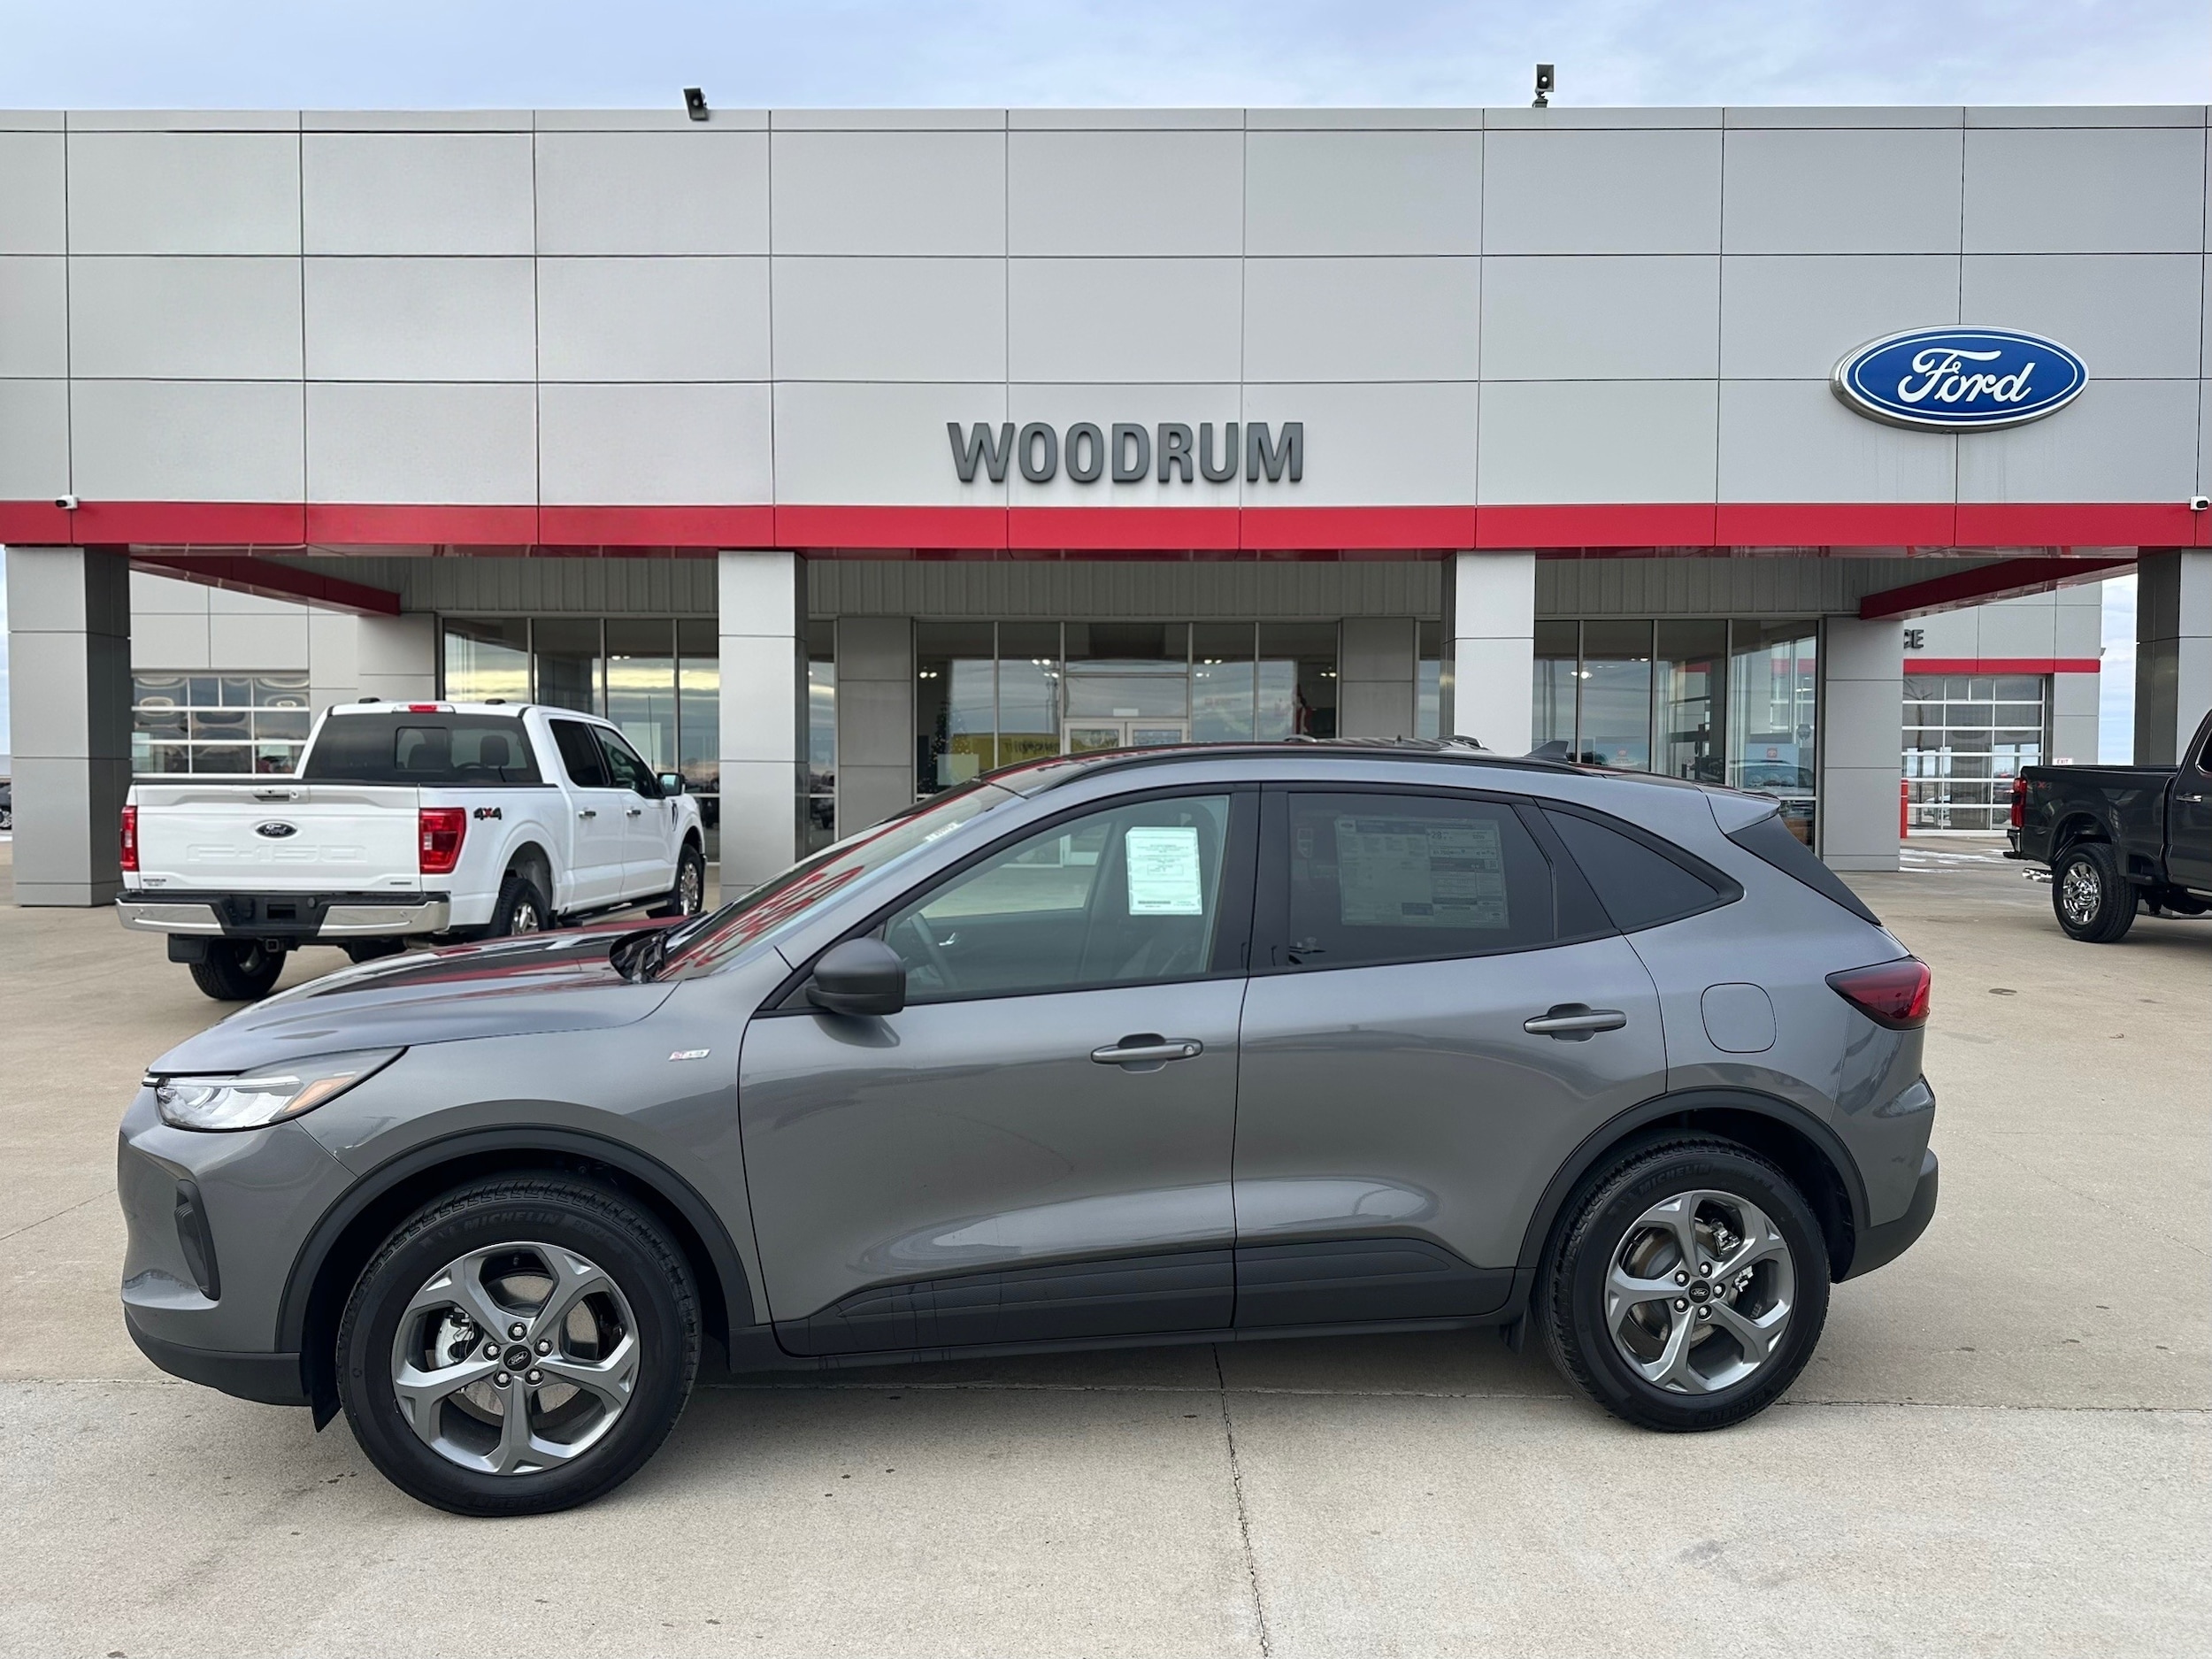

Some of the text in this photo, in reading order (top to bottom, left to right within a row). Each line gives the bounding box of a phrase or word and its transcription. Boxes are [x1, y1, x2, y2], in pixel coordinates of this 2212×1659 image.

[1897, 348, 2036, 403] Ford
[947, 422, 1303, 482] WOODRUM
[187, 843, 367, 864] F-150
[1639, 1163, 1713, 1194] MICHELIN
[464, 1211, 560, 1231] MICHELIN
